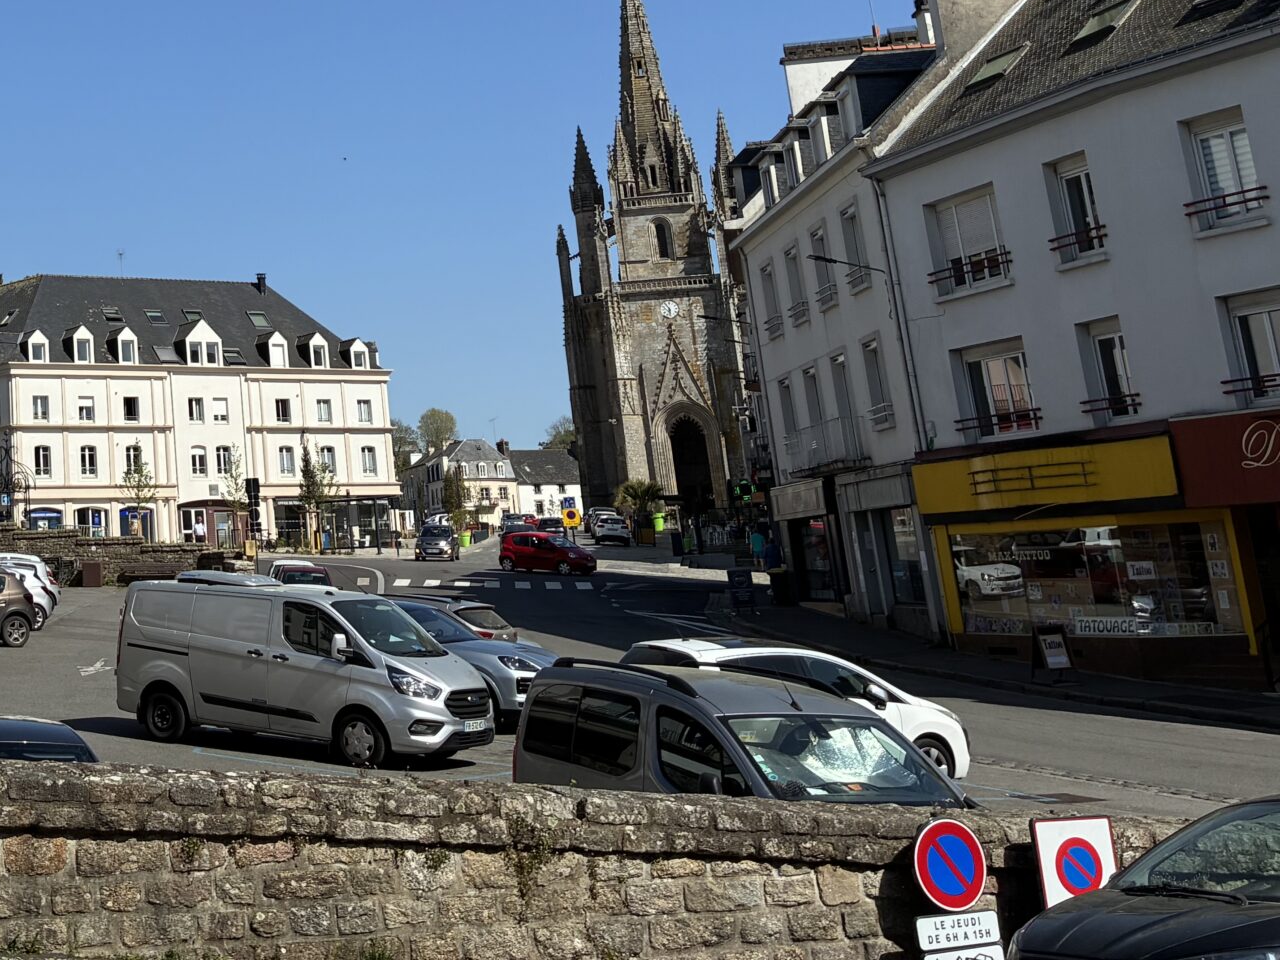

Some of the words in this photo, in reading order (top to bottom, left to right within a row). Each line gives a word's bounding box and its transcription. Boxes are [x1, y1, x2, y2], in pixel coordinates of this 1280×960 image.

[1078, 619, 1135, 634] TATOUAGE
[934, 920, 946, 931] LE
[950, 916, 982, 929] JEUDI
[928, 934, 941, 945] DE
[945, 932, 959, 943] 6H
[963, 930, 970, 941] A
[972, 928, 992, 940] 15H
